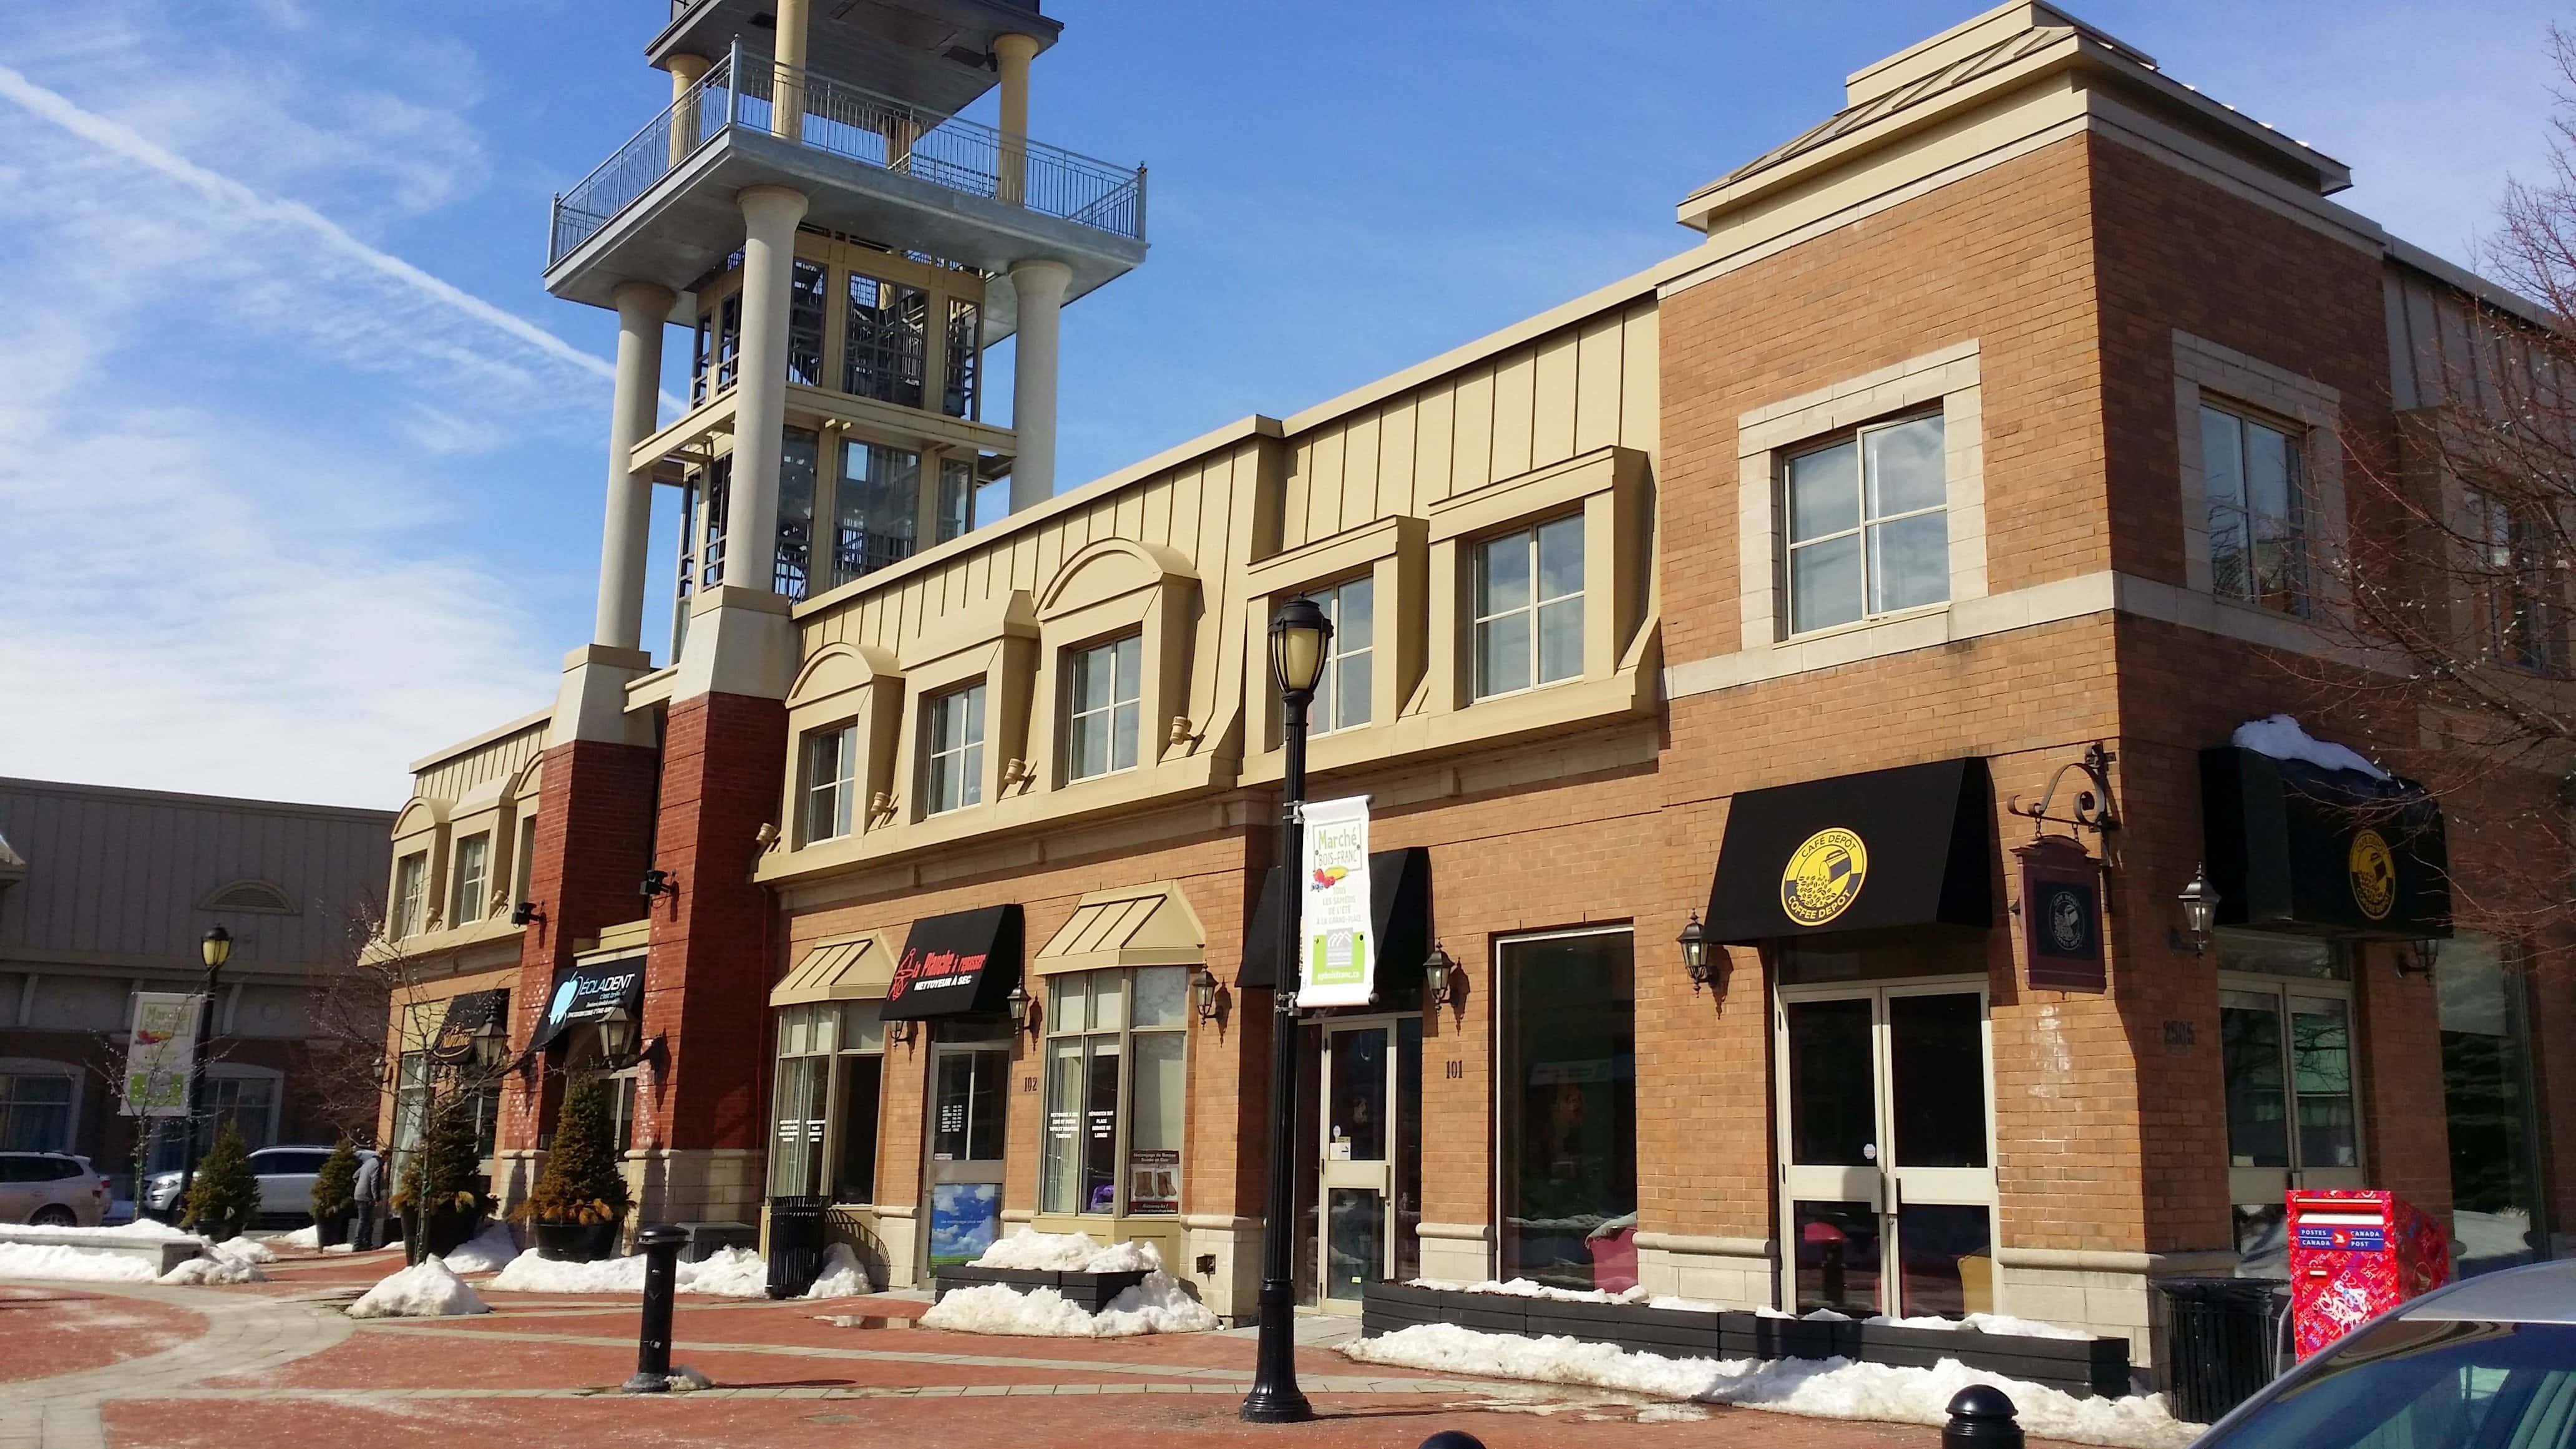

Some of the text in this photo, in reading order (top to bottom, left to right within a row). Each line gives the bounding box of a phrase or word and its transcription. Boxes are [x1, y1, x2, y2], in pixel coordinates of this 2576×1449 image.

[1319, 827, 1357, 851] Marché
[1802, 833, 1856, 857] CAFÉ DÉPÔT
[1319, 849, 1357, 867] BOIS-FRANC
[1788, 889, 1852, 919] COFFEE DEPOT
[914, 975, 972, 991] NETTOYEUR À SEC
[1446, 1060, 1463, 1079] 101
[1024, 1076, 1037, 1092] 102
